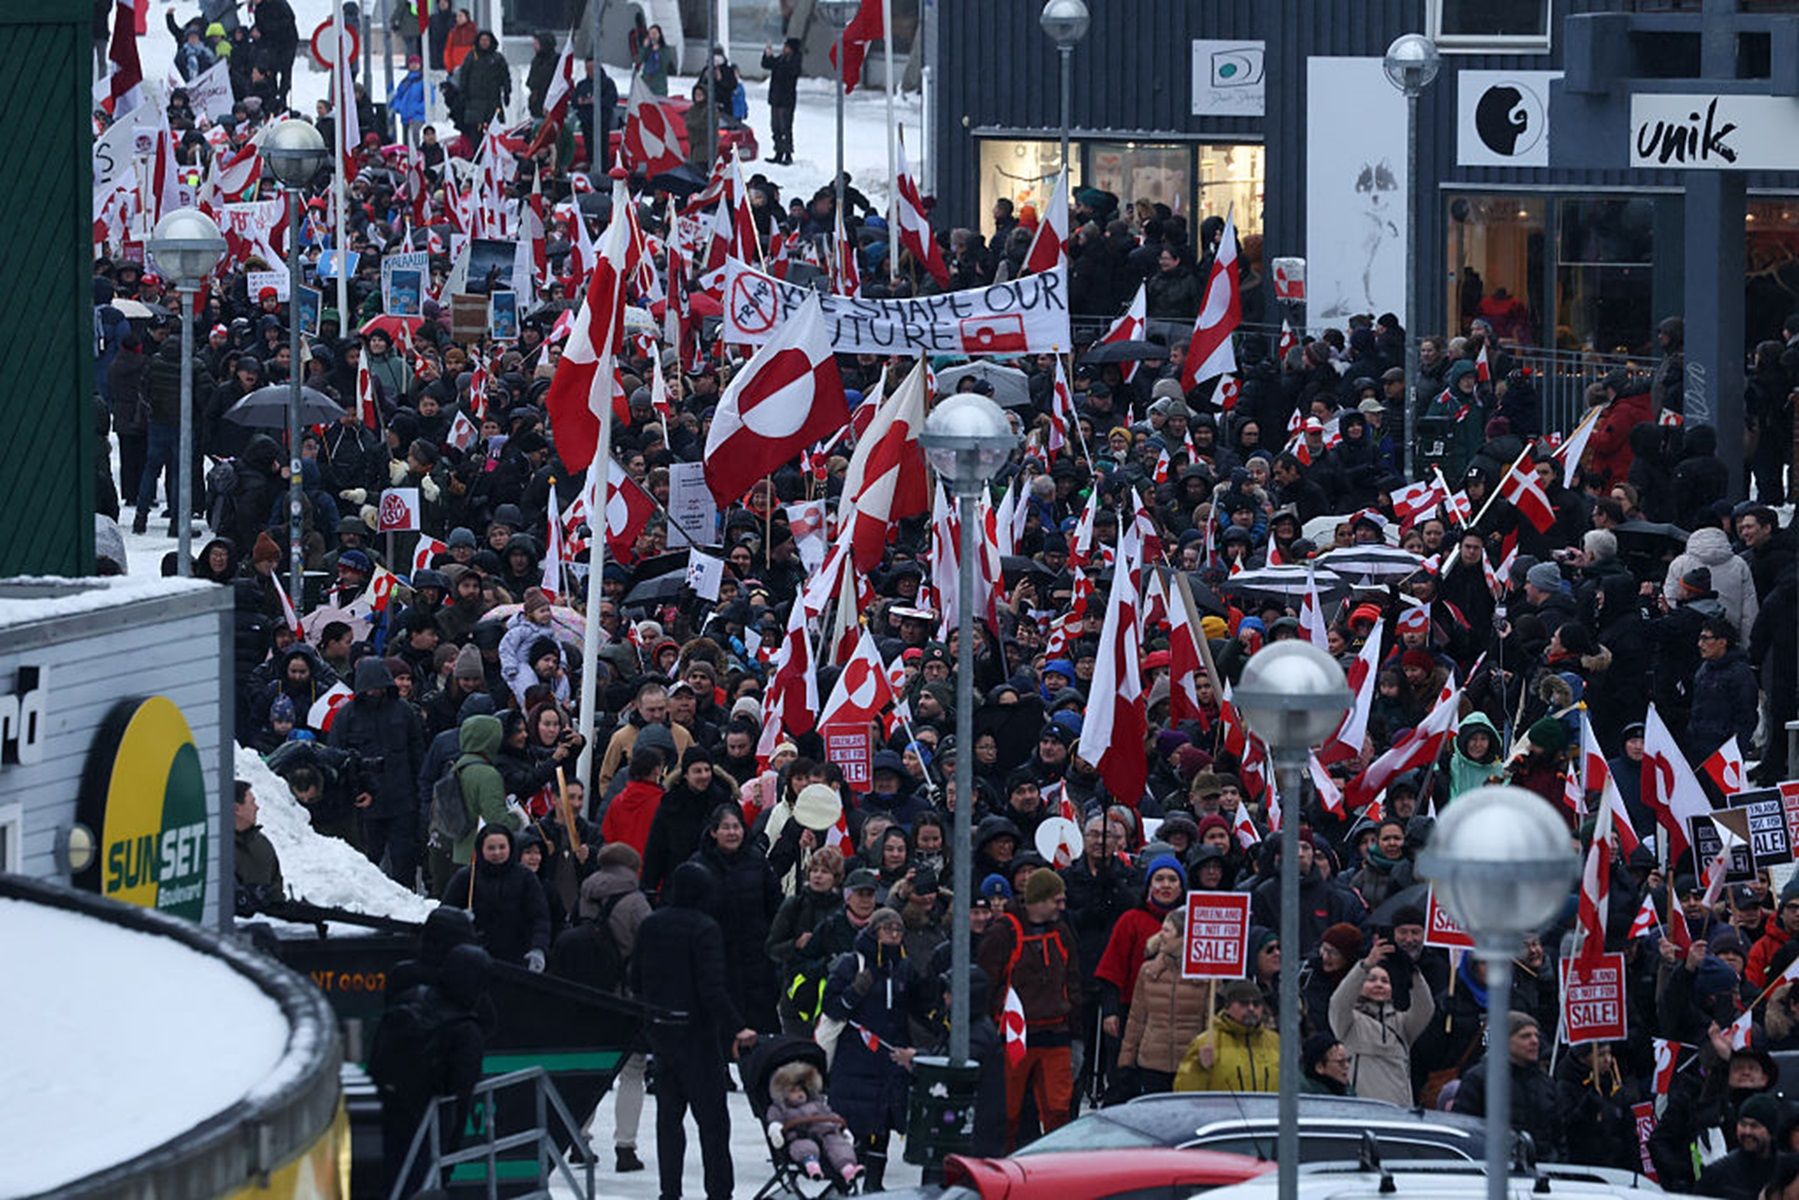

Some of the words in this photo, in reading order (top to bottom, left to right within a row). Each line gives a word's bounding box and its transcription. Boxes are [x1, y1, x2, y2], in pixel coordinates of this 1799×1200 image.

[1637, 96, 1737, 163] unik
[850, 295, 973, 323] SHAPE
[984, 272, 1065, 312] OUR
[842, 763, 866, 781] ALE!
[1754, 832, 1784, 854] ALE!
[1193, 940, 1239, 961] SALE!
[1572, 1003, 1617, 1026] SALE!
